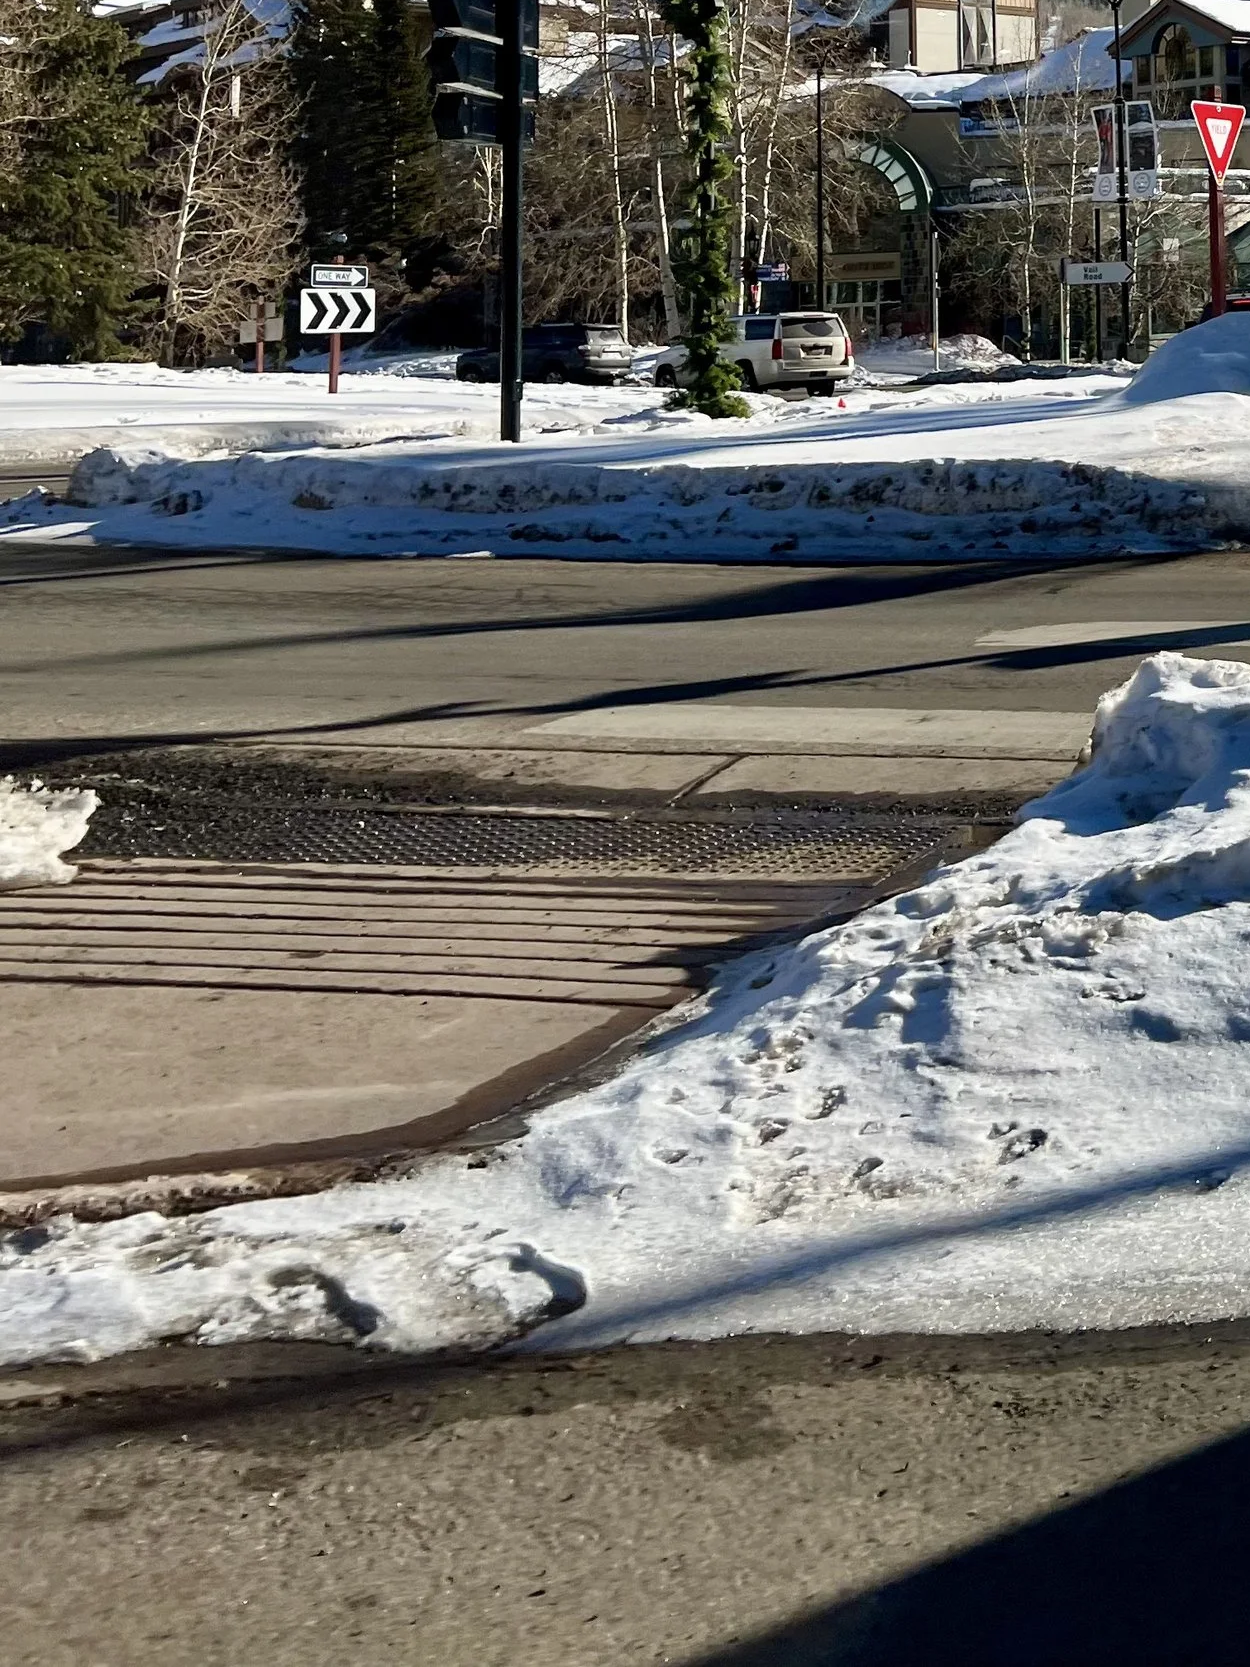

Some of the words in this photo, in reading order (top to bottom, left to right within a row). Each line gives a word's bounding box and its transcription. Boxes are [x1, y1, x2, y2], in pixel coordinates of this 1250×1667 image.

[1211, 124, 1228, 135] YIELD
[317, 272, 333, 281] ONE
[335, 272, 351, 281] WAY
[1083, 273, 1103, 281] Road
